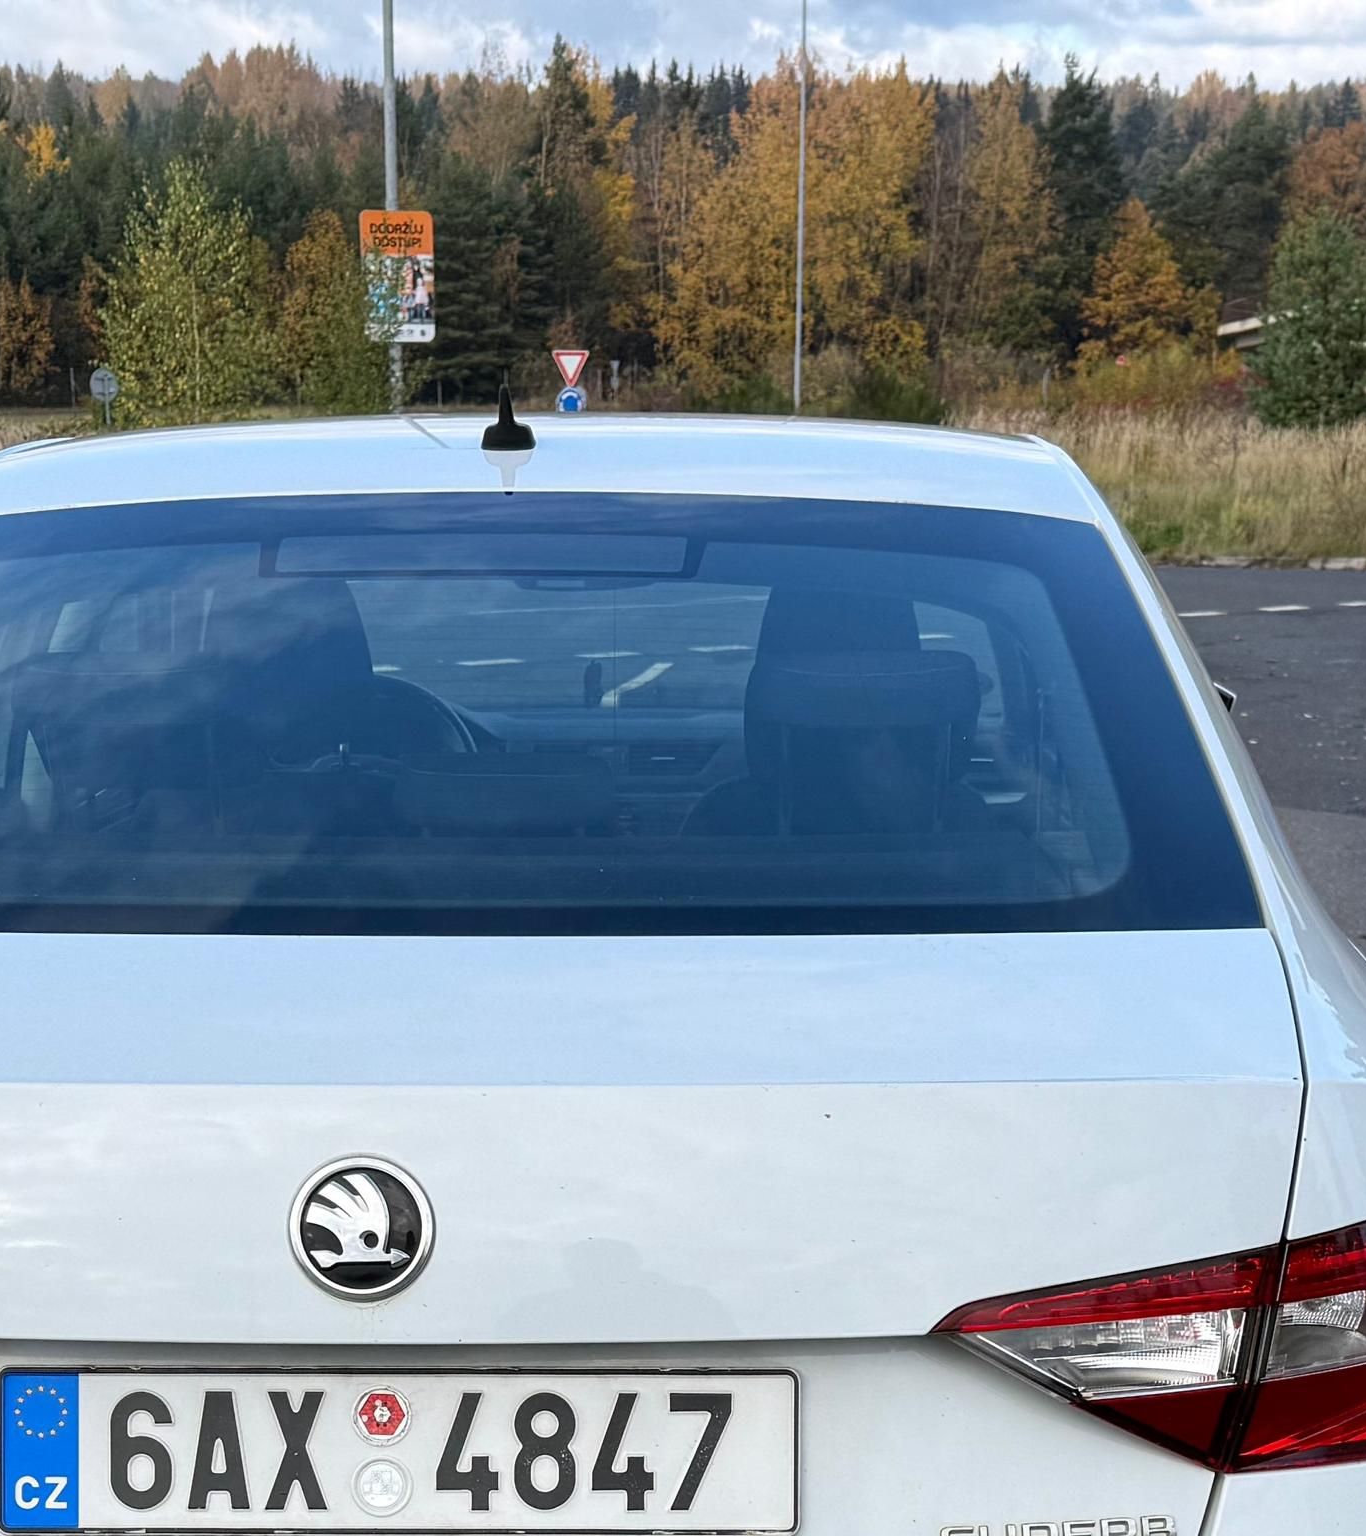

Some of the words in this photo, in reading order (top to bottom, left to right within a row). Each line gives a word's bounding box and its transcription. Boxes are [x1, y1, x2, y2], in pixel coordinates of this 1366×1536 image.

[110, 1390, 328, 1511] 6AX
[435, 1392, 733, 1511] 4847
[14, 1475, 69, 1510] CZ
